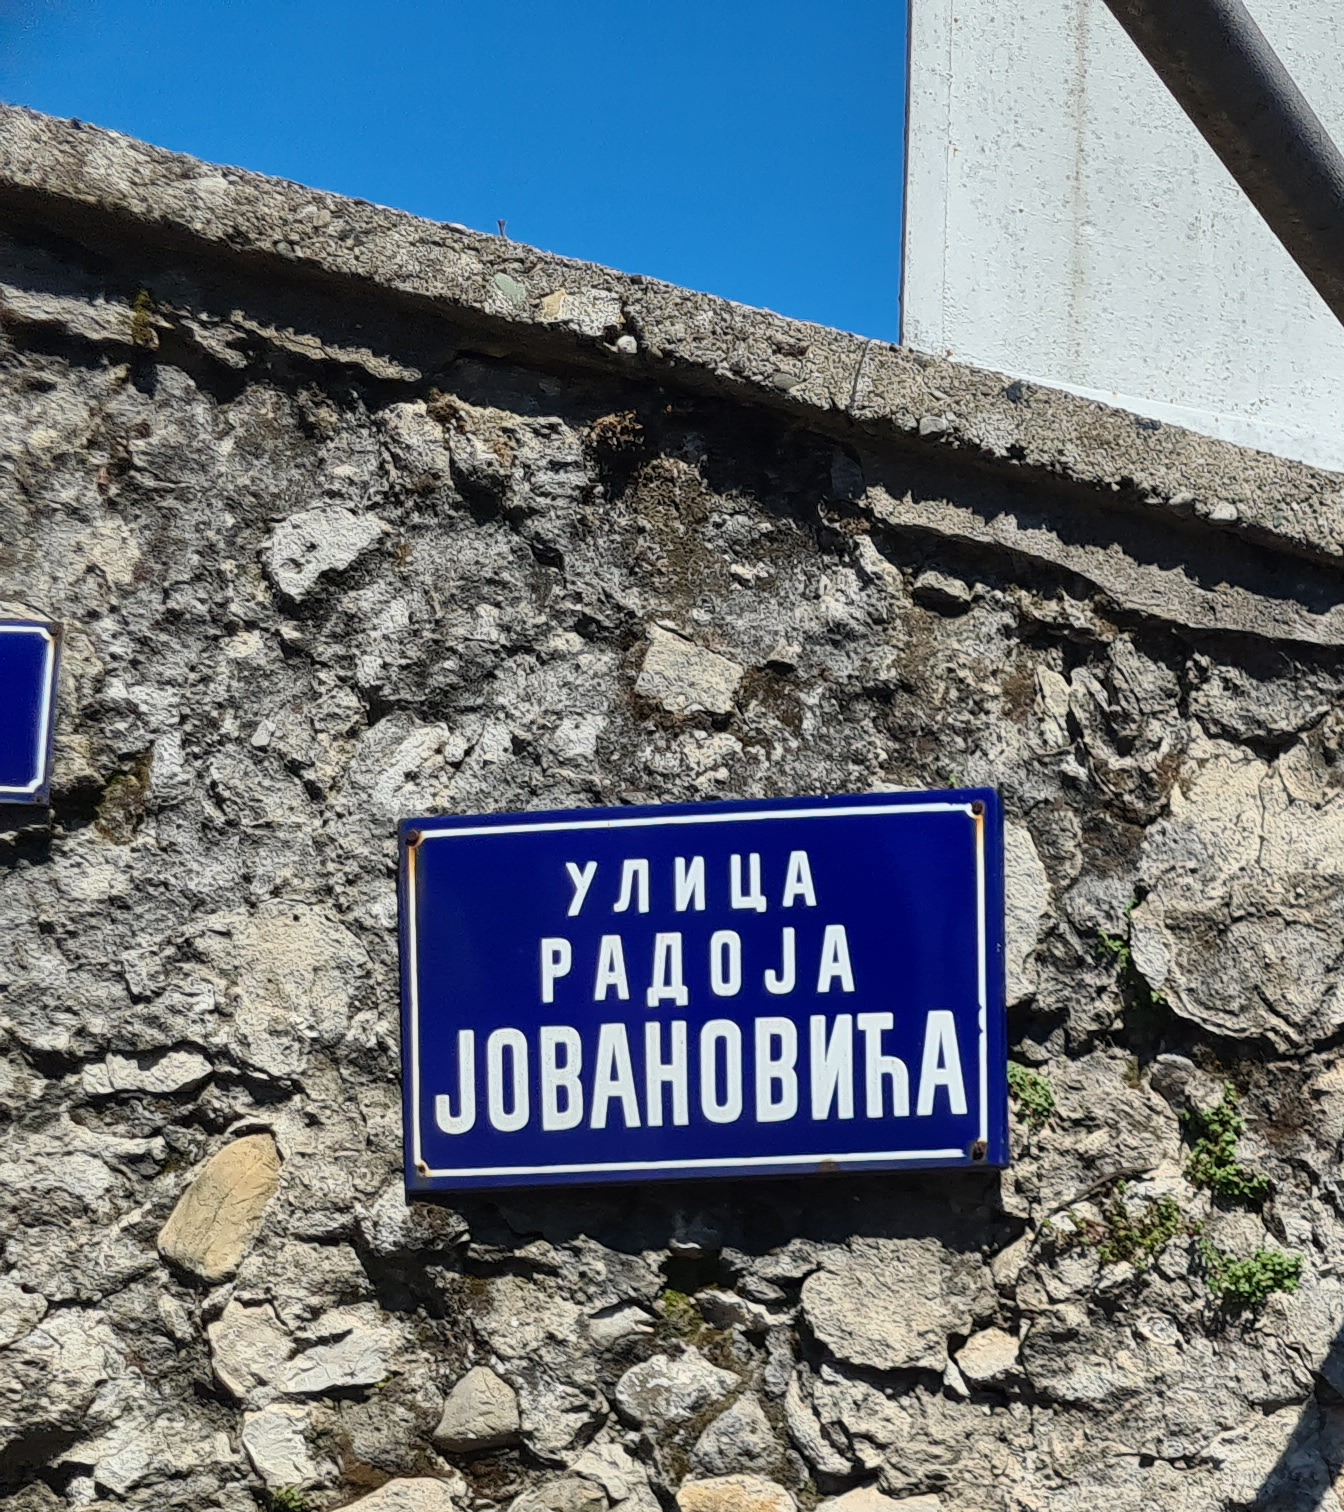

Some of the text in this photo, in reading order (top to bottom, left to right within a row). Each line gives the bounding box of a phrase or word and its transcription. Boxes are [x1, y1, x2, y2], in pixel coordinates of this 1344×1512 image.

[566, 850, 816, 916] УЛИЦА
[541, 924, 854, 1006] РАДОЈА
[435, 1010, 968, 1134] ЈОВАНОВИЋА
